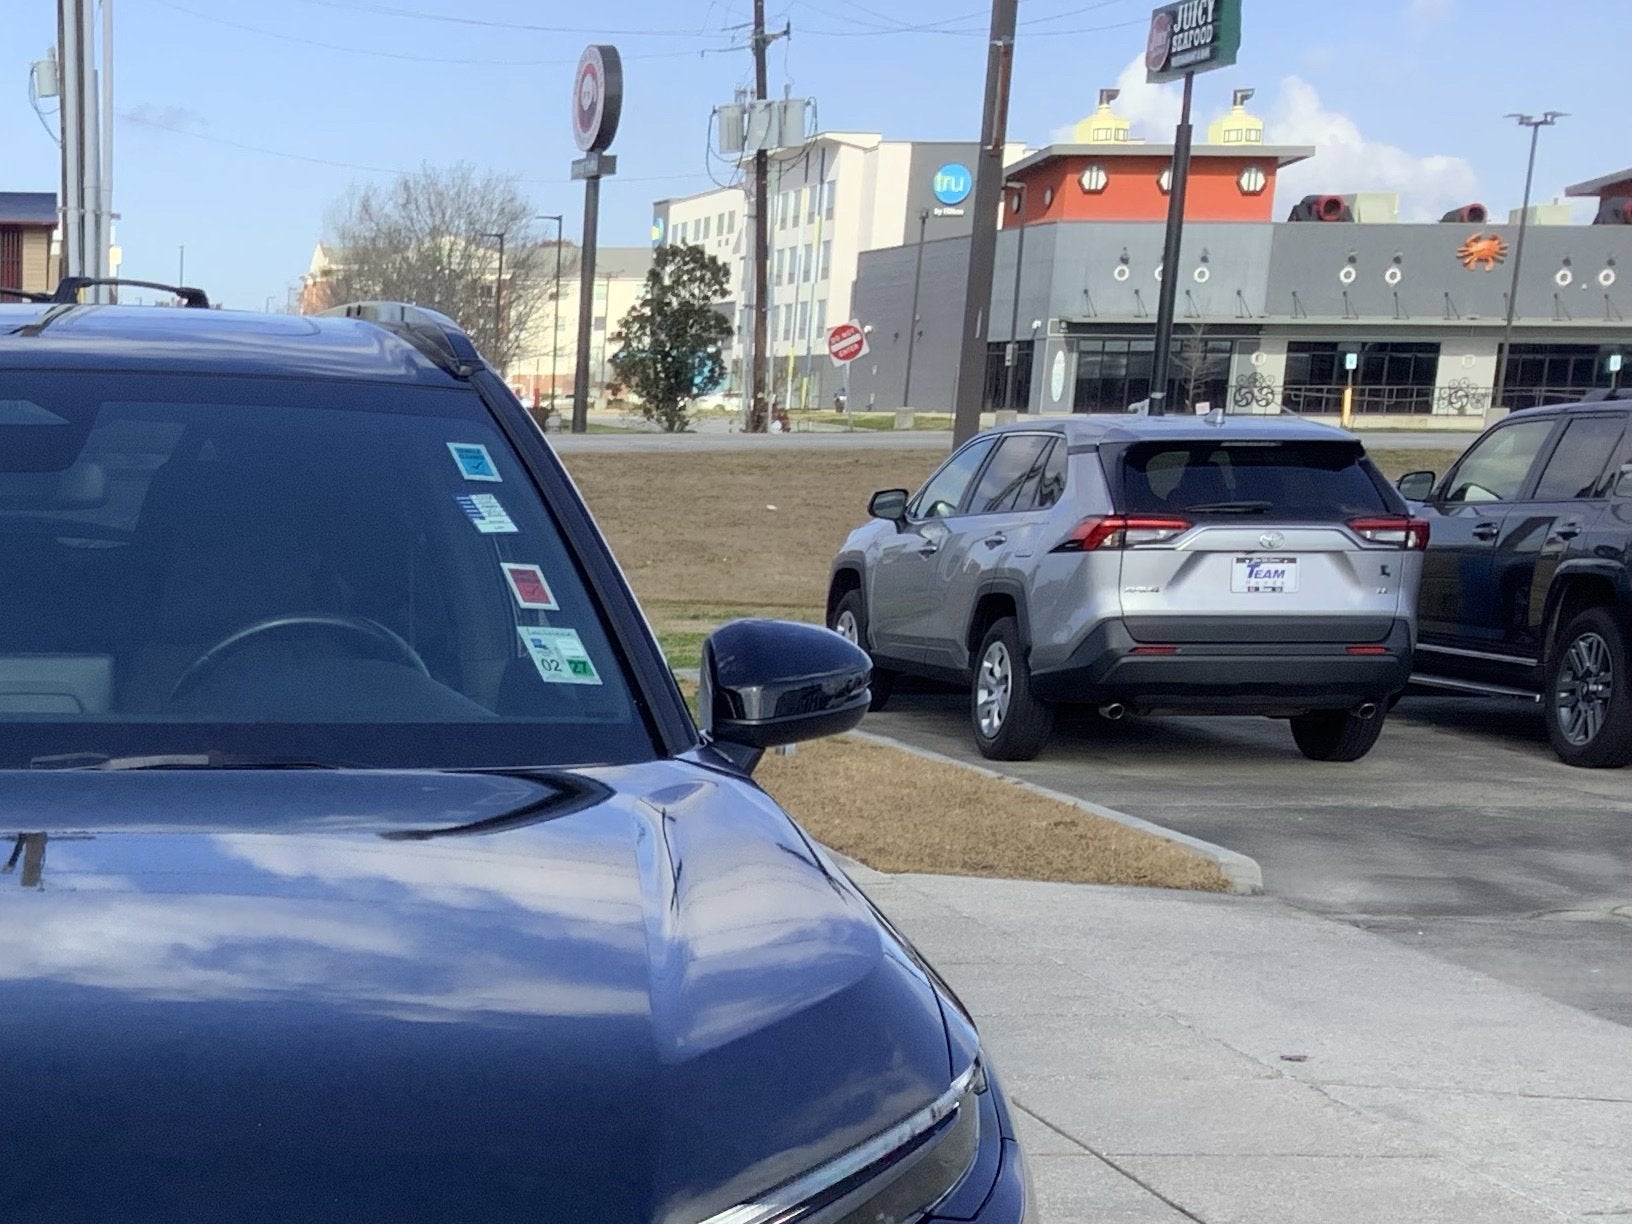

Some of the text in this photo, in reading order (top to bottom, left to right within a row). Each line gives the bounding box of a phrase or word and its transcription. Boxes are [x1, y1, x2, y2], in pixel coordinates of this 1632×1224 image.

[1173, 0, 1215, 33] JUICY
[1171, 24, 1213, 53] SEAFOOD
[934, 171, 965, 193] tru
[1246, 561, 1286, 579] TEAM
[541, 658, 588, 675] 02 27
